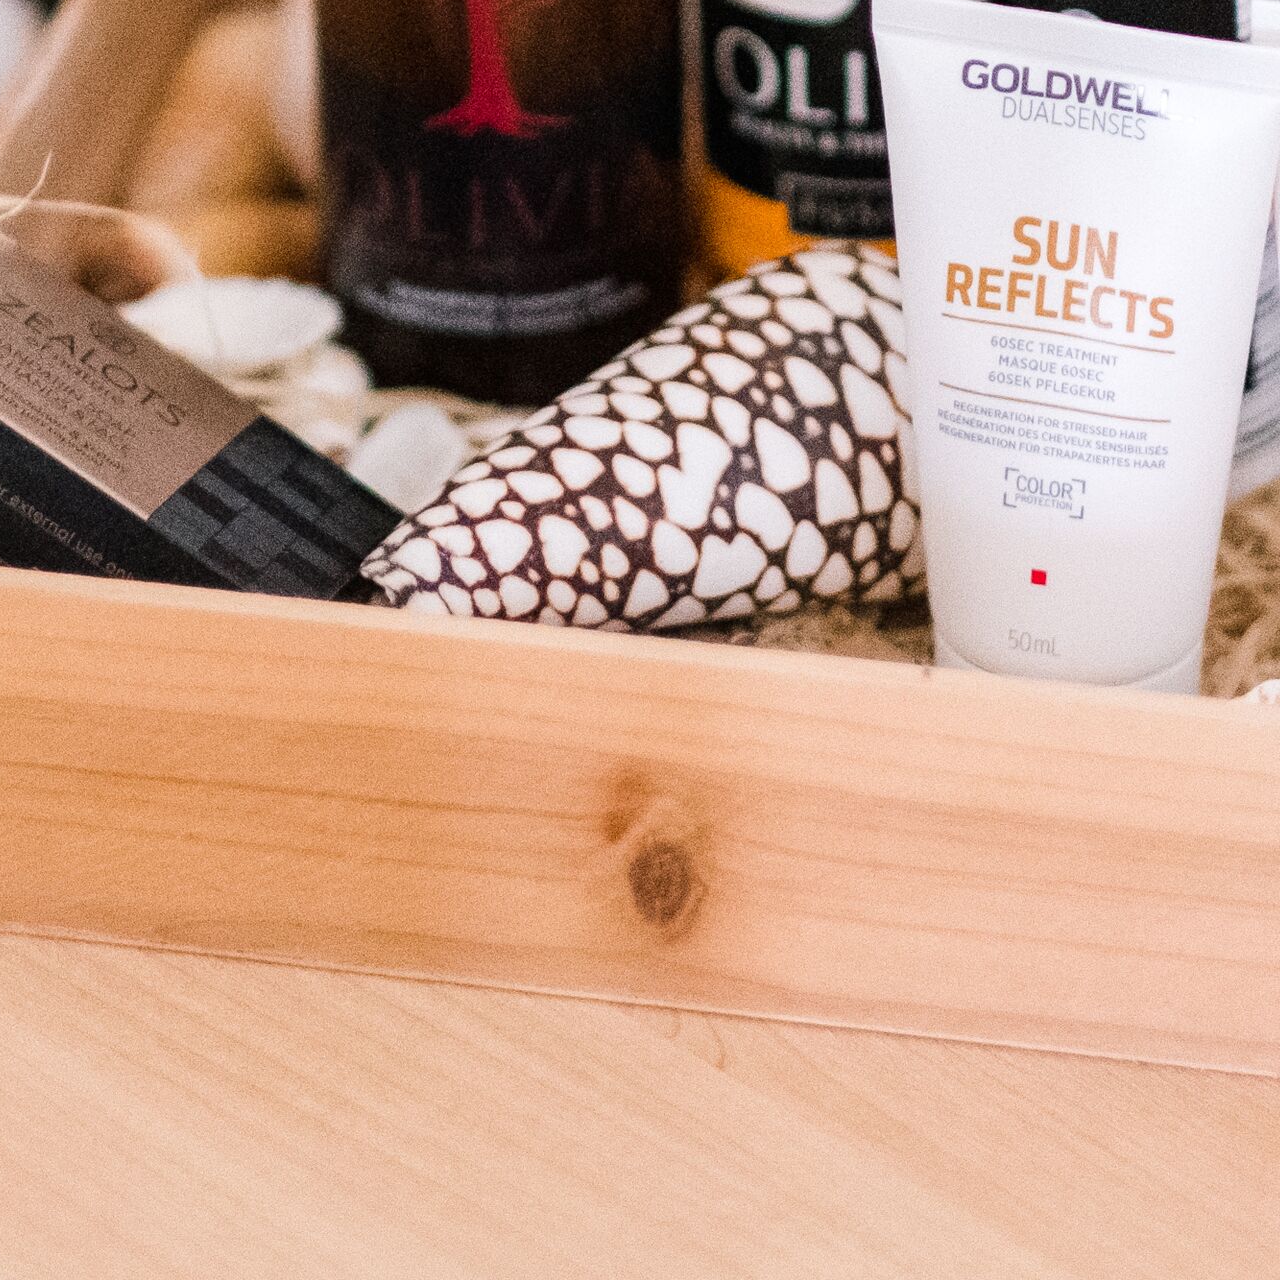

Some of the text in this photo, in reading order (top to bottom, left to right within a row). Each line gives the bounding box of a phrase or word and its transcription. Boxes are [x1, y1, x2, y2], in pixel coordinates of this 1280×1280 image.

[713, 24, 870, 128] OLI
[1001, 96, 1146, 140] DUALSENSES
[1012, 215, 1119, 280] SUN
[945, 262, 1175, 339] REFLECTS
[991, 335, 1119, 366] 60SEC TREATMENT
[988, 371, 1116, 401] 60SEK PFLEGEKUR
[999, 355, 1104, 383] MASQUE 60SEC
[954, 400, 1148, 441] REGENERATION FOR STRESSED HAIR
[1018, 427, 1039, 440] DES
[1041, 431, 1092, 449] CHEVEUX
[939, 423, 1016, 450] REGENERATION
[1043, 447, 1130, 468] STRAPAZIERTES
[1134, 459, 1166, 469] HAAR
[1015, 493, 1073, 511] PROTECTION
[1016, 474, 1073, 500] COLOR
[8, 495, 77, 544] external
[74, 540, 104, 565] use
[1006, 628, 1061, 658] 50mL
